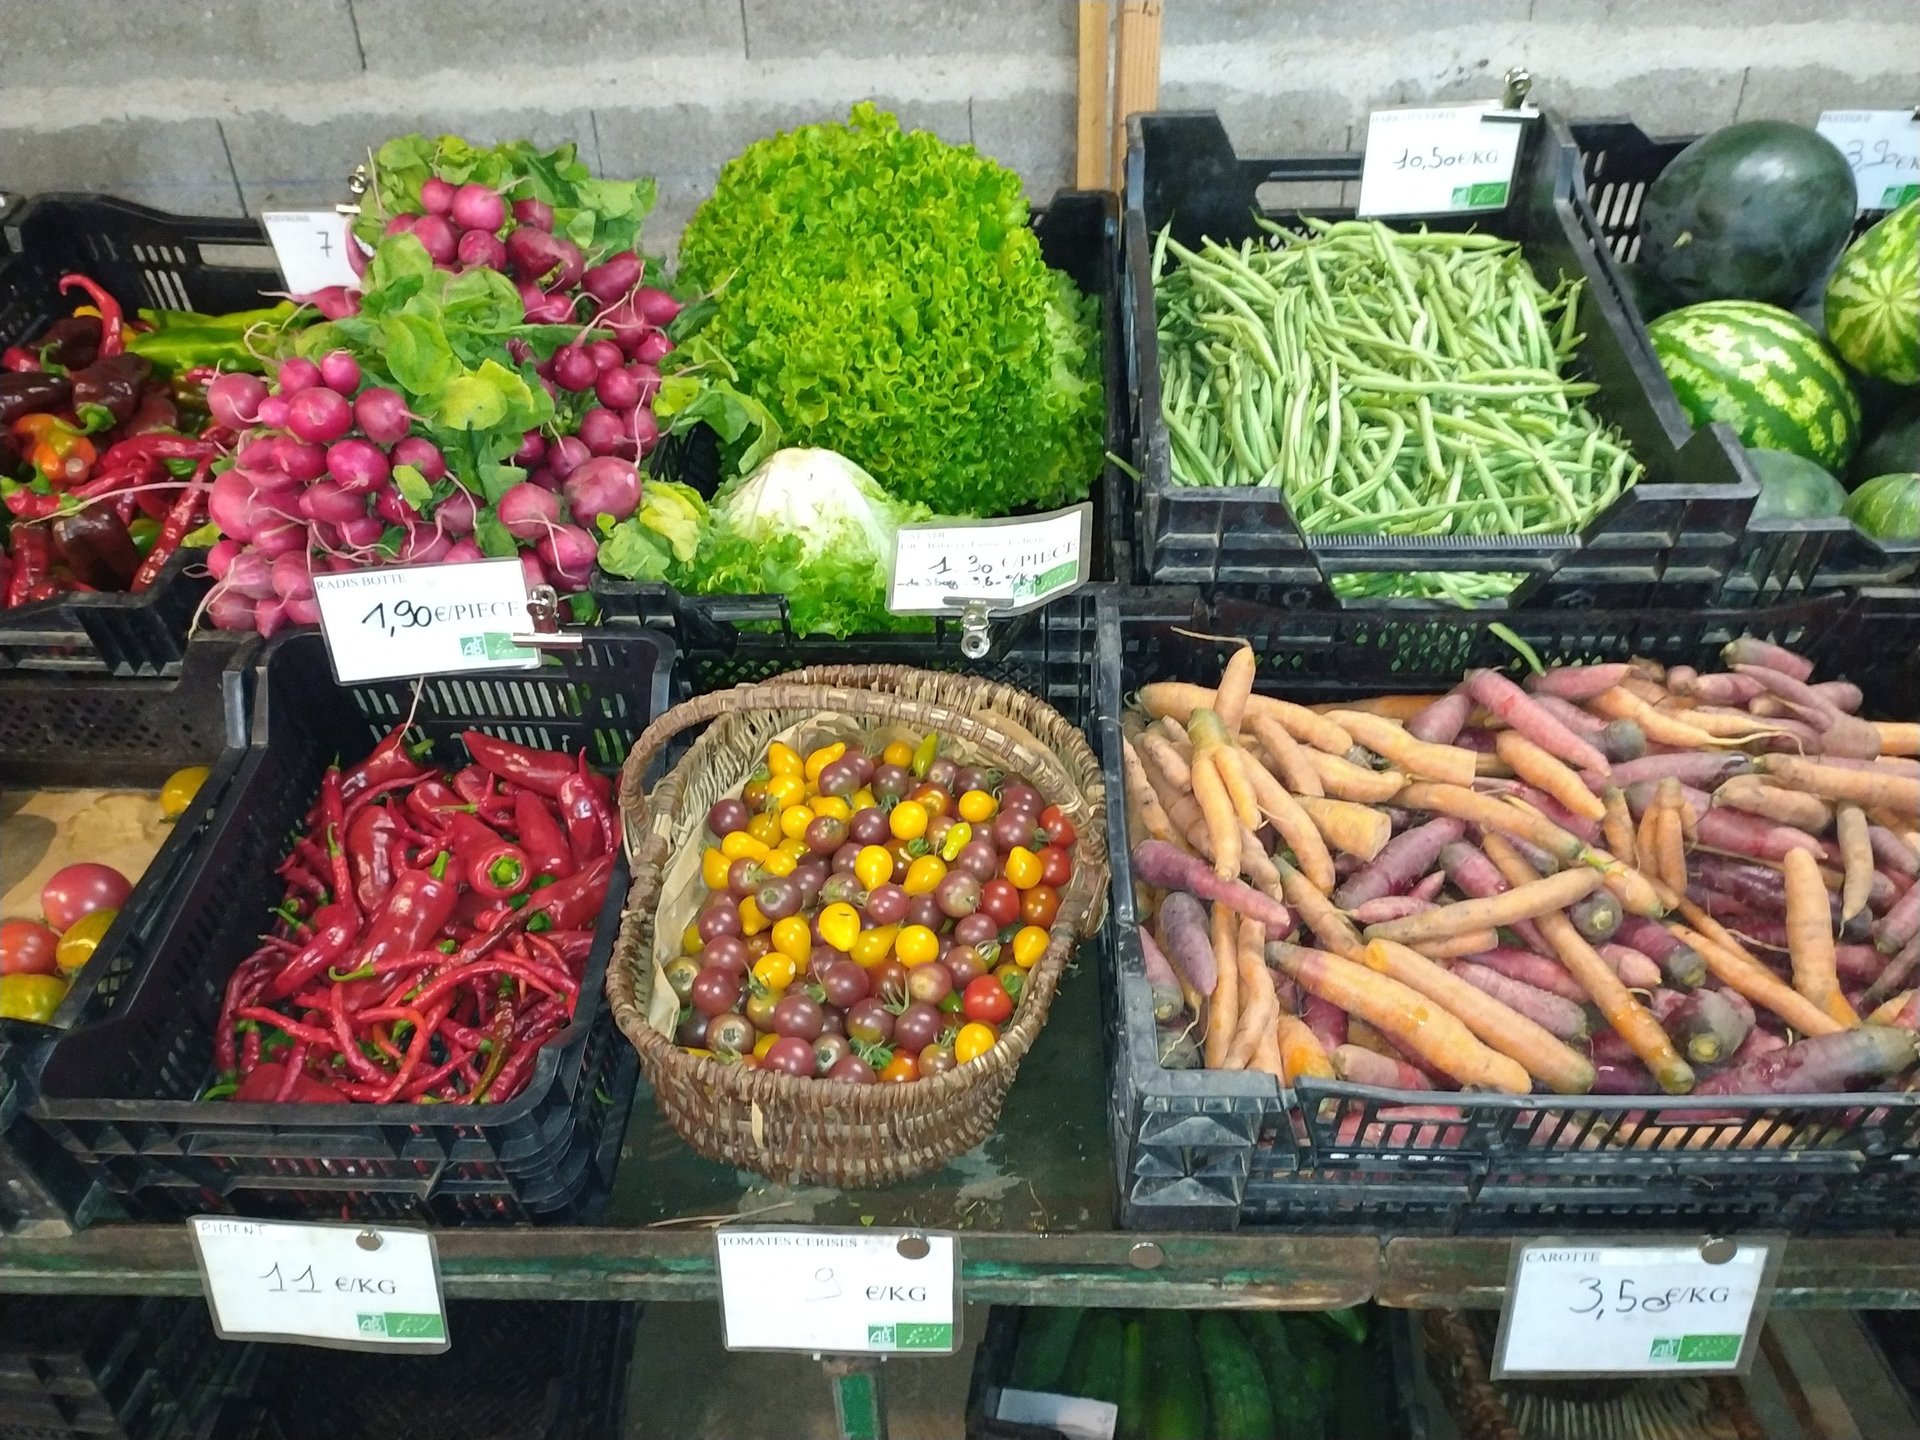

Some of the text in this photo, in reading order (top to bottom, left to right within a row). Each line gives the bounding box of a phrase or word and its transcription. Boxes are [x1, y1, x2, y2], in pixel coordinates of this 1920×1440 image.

[316, 231, 333, 258] 7
[316, 573, 407, 591] RADIS BOTTE
[201, 1222, 269, 1235] PIMENT
[721, 1236, 858, 1248] TOMATES CERISES
[1526, 1251, 1597, 1263] CAROTTE
[258, 1262, 396, 1294] 11 €/KG
[866, 1285, 927, 1302] €/KG
